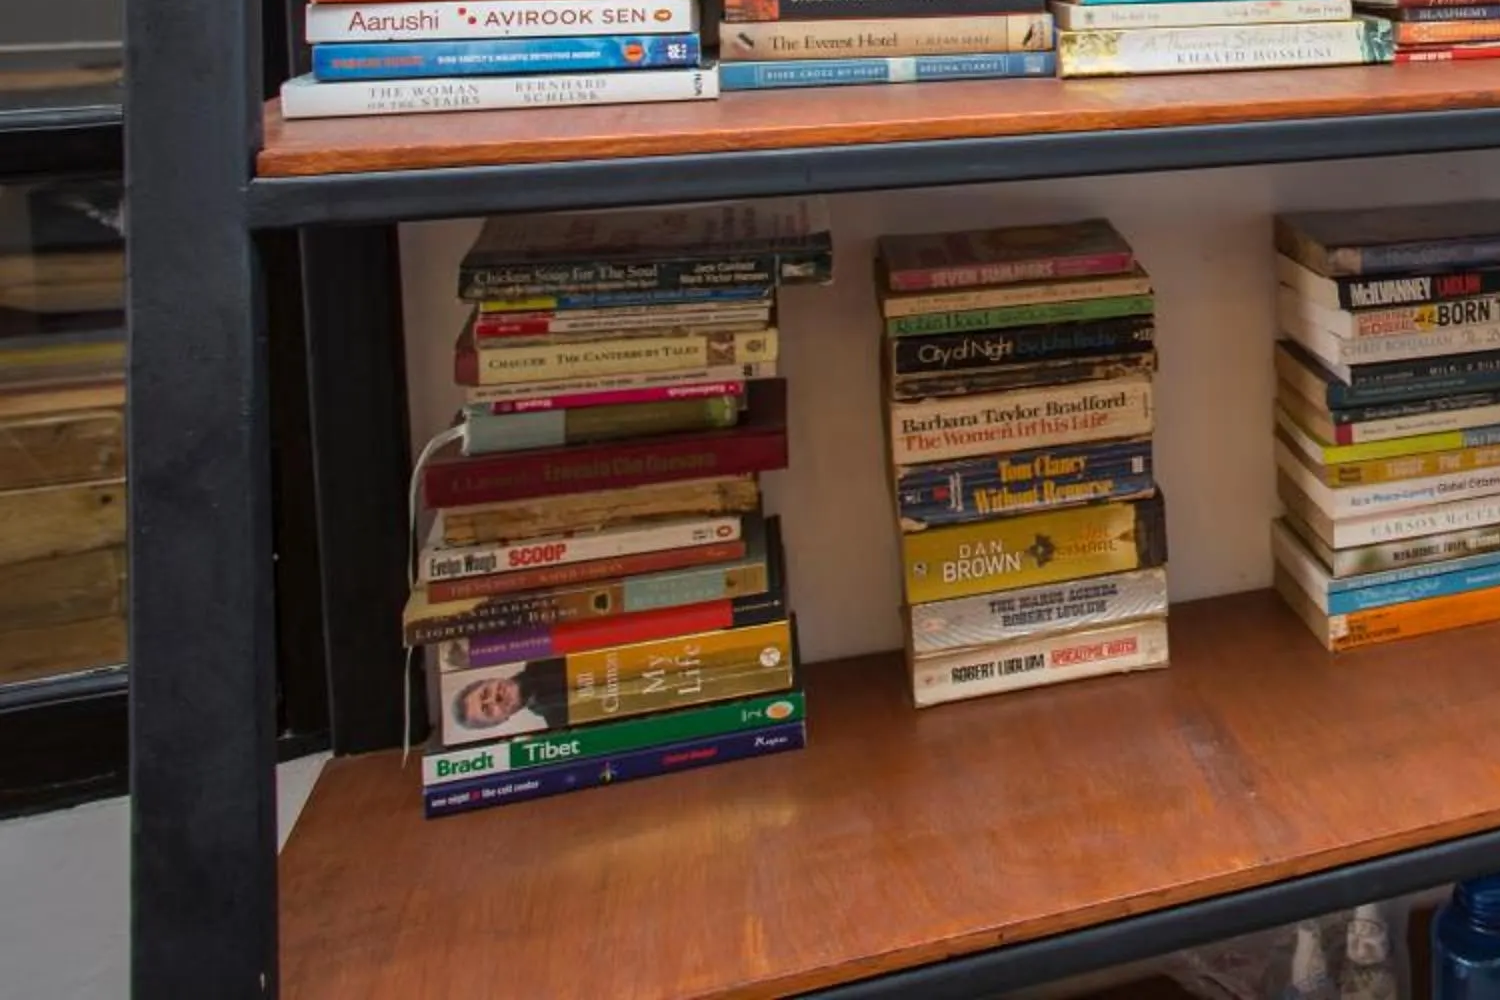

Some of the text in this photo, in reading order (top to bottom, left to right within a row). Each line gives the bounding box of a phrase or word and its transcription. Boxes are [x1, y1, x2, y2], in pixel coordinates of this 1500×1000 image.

[348, 7, 646, 32] Aarushi AVIROOK SEN
[768, 32, 899, 51] The Everest Hotel
[1177, 47, 1333, 65] KHALED HOSSEINI
[368, 78, 607, 99] THE WOMAN BERNHARD
[419, 95, 481, 107] STAIRS
[473, 268, 532, 288] Chicken
[535, 268, 569, 286] Soup
[600, 264, 626, 281] The
[627, 263, 659, 279] Soul
[929, 267, 977, 288] SEVEN
[1437, 300, 1491, 326] BORN
[488, 344, 699, 370] CHAUCER THE CANTERBURY TALES
[916, 334, 1014, 366] City of Night
[902, 392, 1127, 434] Barbara Taylor Bradford
[904, 411, 1109, 455] The Women in his Life
[999, 454, 1088, 482] Tom Clancy
[974, 479, 1114, 514] Without Remorse
[1436, 476, 1500, 496] Global Citizen
[1369, 515, 1438, 537] CARSON
[429, 543, 567, 578] Evelyn Waugh SCOOP
[959, 539, 1003, 559] DAN
[942, 552, 1022, 583] BROWN
[988, 599, 1016, 613] THE
[1001, 600, 1107, 627] ROBERT LUDLUM
[641, 655, 673, 695] My
[677, 643, 702, 697] Life
[951, 661, 995, 684] ROBERT
[997, 653, 1045, 675] LUDLUM
[576, 670, 596, 700] Bill
[602, 652, 621, 714] Clinton
[435, 738, 581, 778] Bradt Tibet
[447, 791, 470, 806] night
[482, 787, 496, 799] the
[497, 784, 513, 796] call
